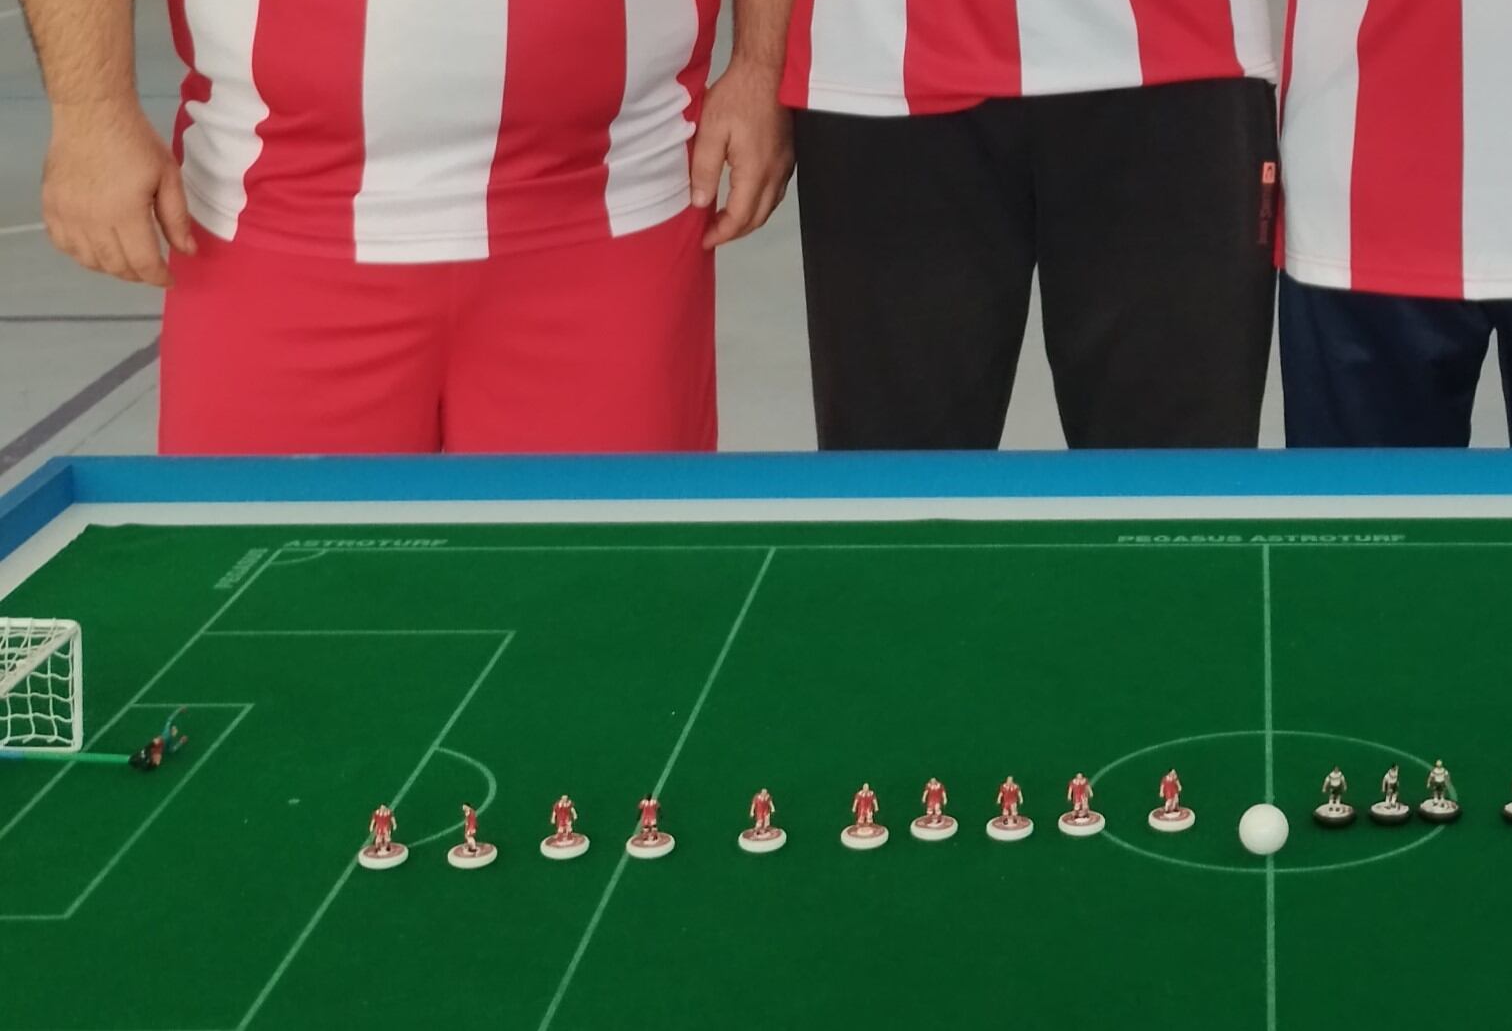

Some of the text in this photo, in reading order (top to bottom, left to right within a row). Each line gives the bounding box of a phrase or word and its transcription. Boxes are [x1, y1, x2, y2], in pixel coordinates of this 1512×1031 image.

[282, 538, 449, 548] ASTROTURF
[1117, 534, 1406, 543] PEGASUS ASTROTURF
